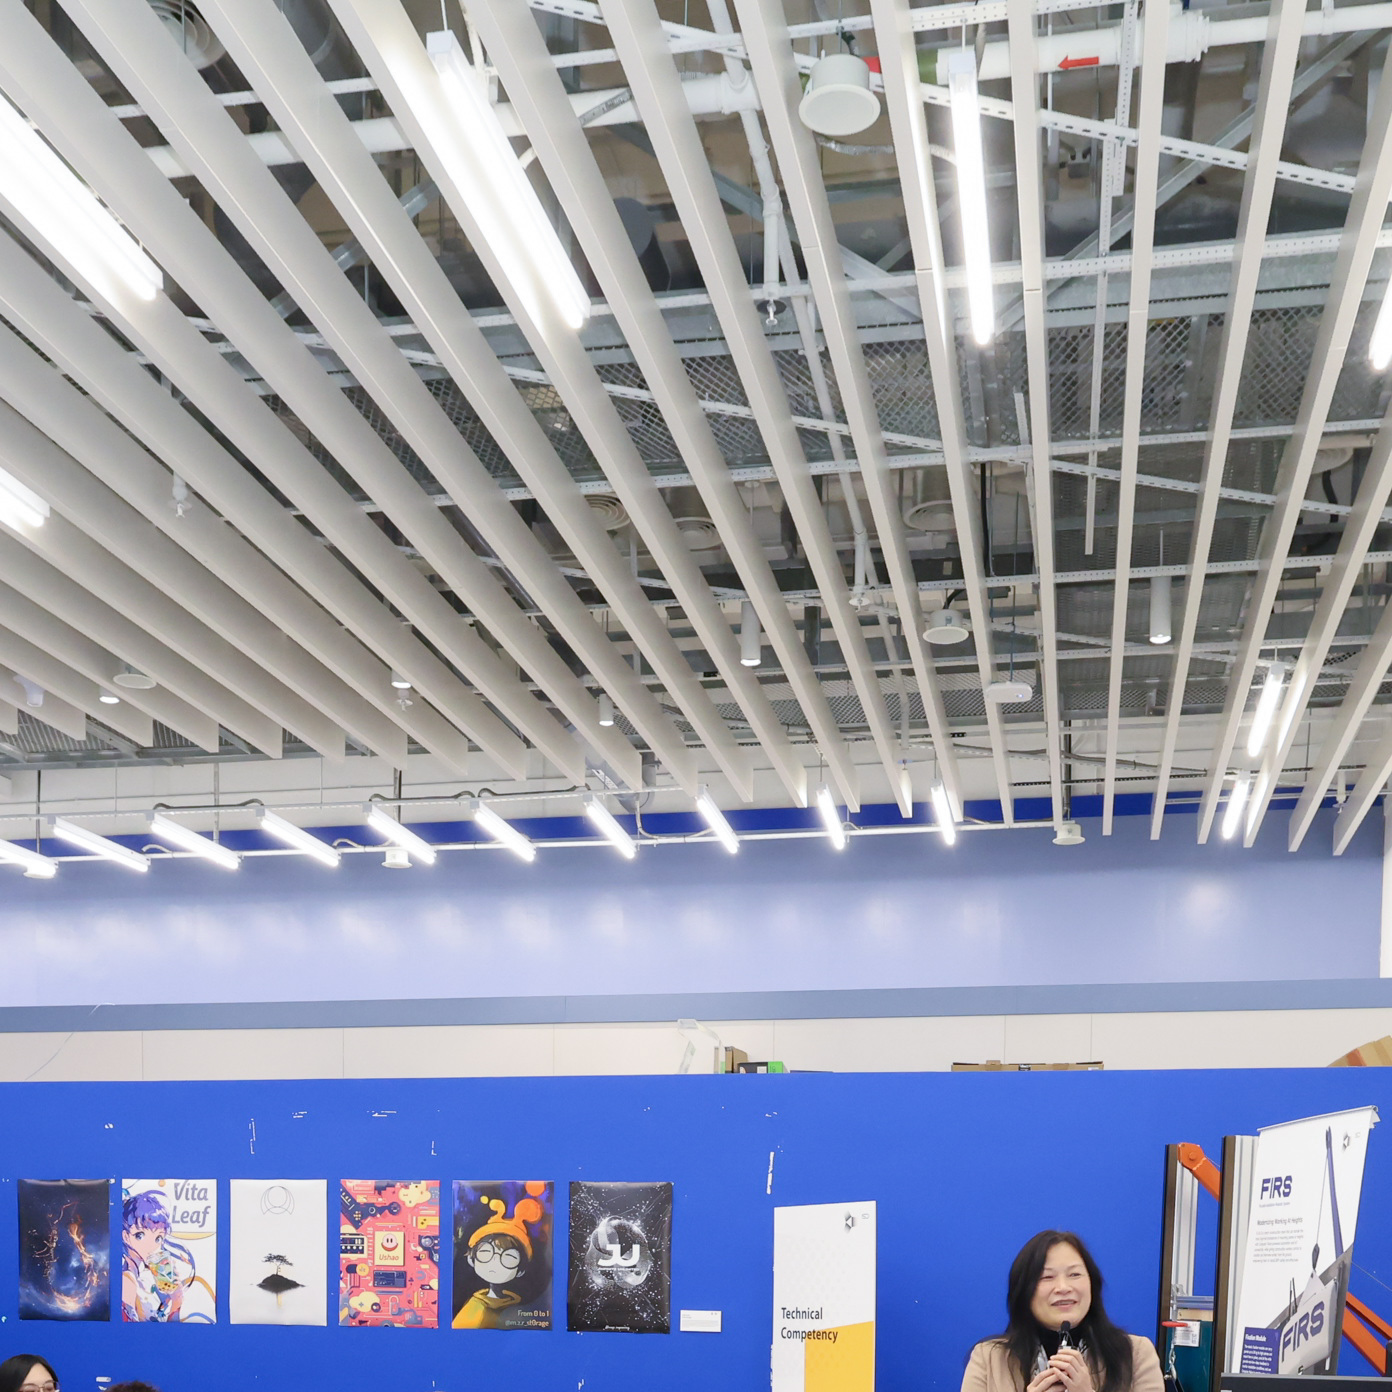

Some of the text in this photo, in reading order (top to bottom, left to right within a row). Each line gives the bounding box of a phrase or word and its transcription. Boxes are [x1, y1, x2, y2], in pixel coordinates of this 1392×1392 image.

[173, 1179, 209, 1201] Vita
[1260, 1175, 1293, 1200] FIRS
[172, 1205, 211, 1228] Leaf
[781, 1307, 823, 1320] Technical
[780, 1326, 839, 1344] Competency
[1281, 1300, 1325, 1364] FIRS
